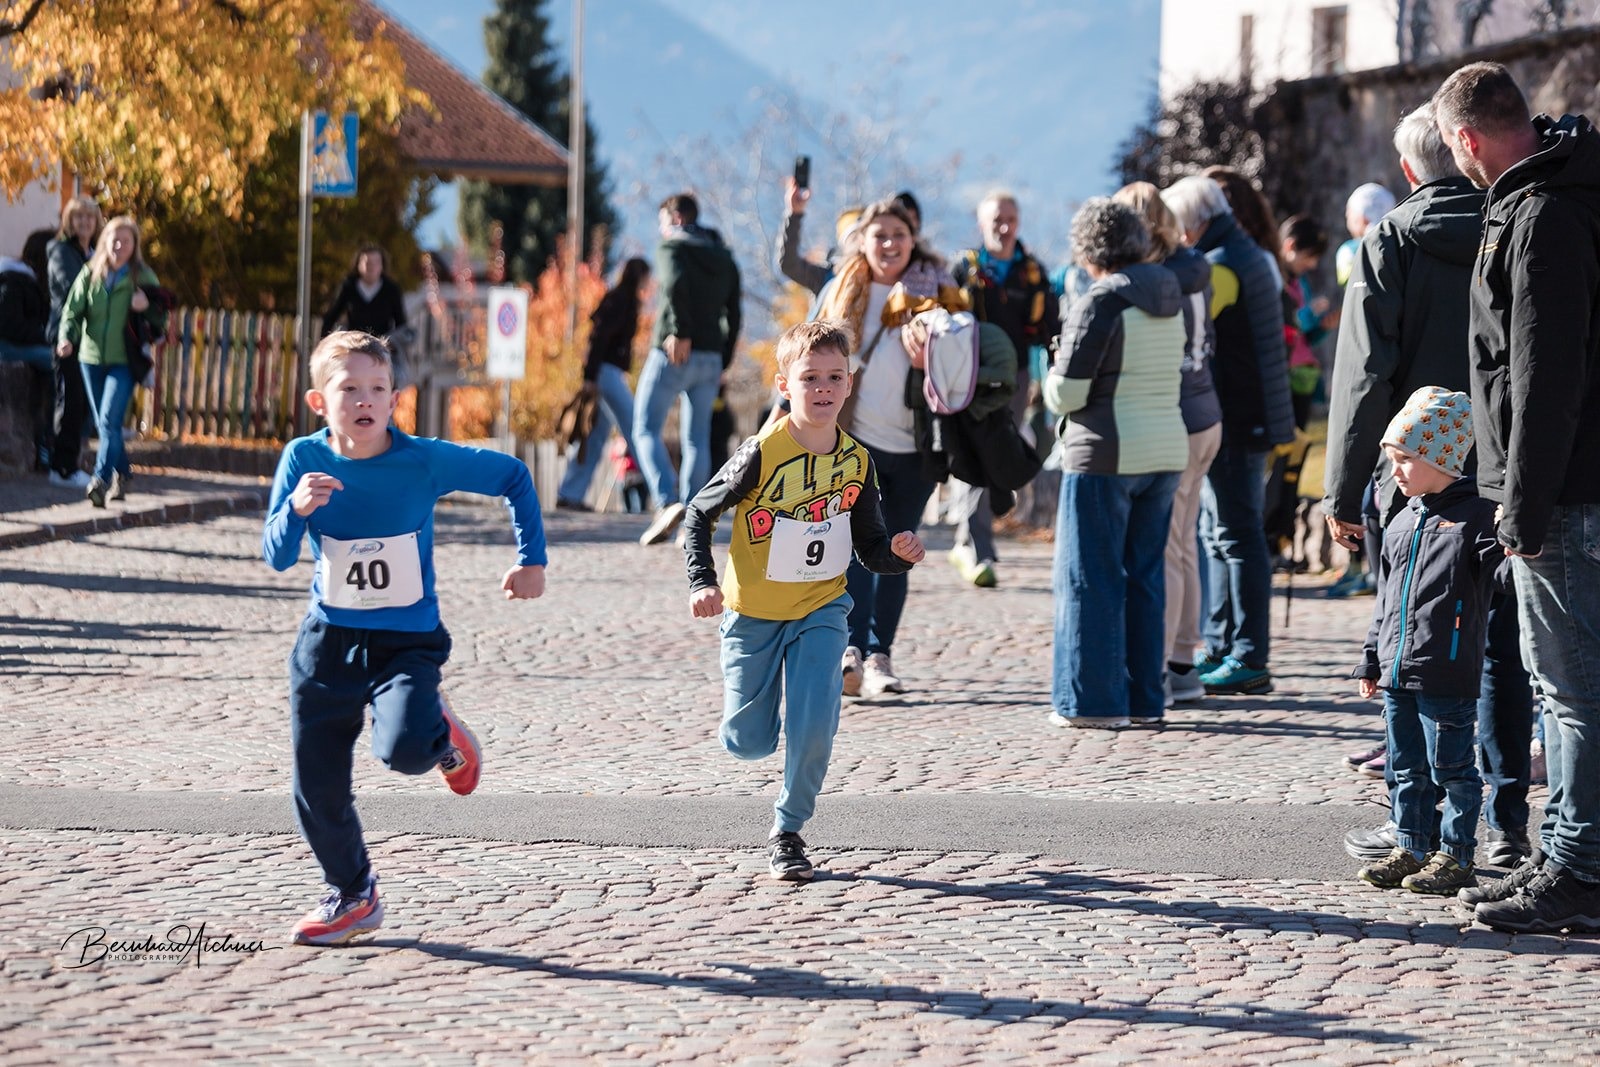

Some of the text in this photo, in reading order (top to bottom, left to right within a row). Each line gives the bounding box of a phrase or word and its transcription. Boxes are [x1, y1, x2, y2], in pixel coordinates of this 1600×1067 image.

[747, 482, 863, 542] DCTOR
[805, 540, 825, 566] 9
[346, 559, 391, 590] 40
